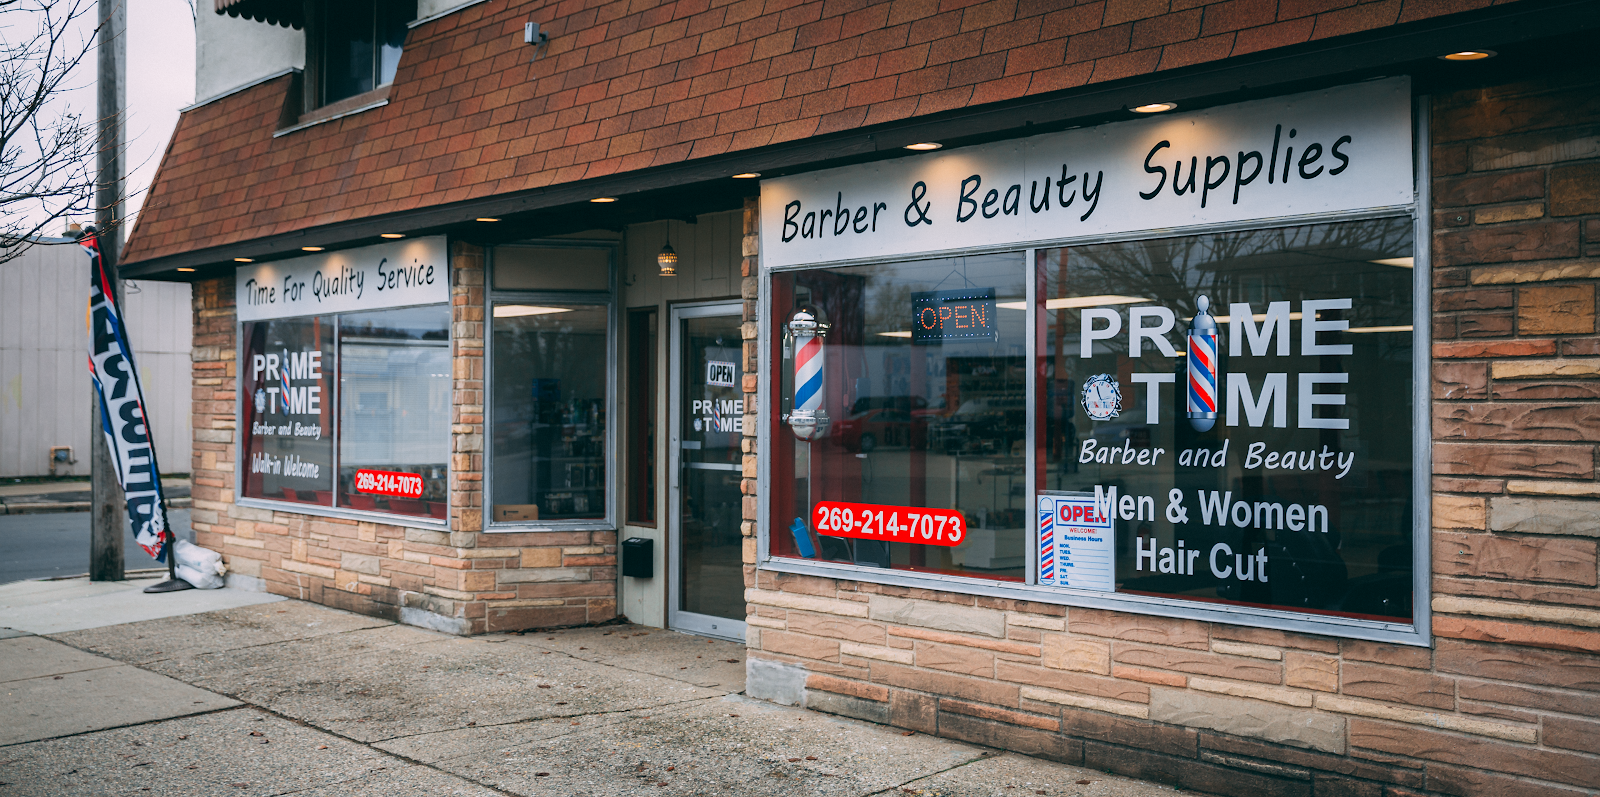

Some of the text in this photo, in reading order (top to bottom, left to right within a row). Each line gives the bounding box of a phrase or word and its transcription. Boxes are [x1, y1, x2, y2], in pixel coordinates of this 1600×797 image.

[781, 124, 1351, 243] Barber & Beauty Supplies
[245, 257, 435, 306] Time For Quality Service
[920, 303, 986, 330] OPEN
[710, 364, 733, 383] OPEN
[252, 420, 322, 440] Barber and Beauty
[251, 452, 320, 479] Walk-in Welcome
[1079, 438, 1355, 480] Barber and Beauty
[356, 471, 422, 496] 269-214-7073
[817, 506, 962, 543] 269-214-7073
[1093, 484, 1329, 533] Men & Women
[1135, 537, 1269, 583] Hair Cut
